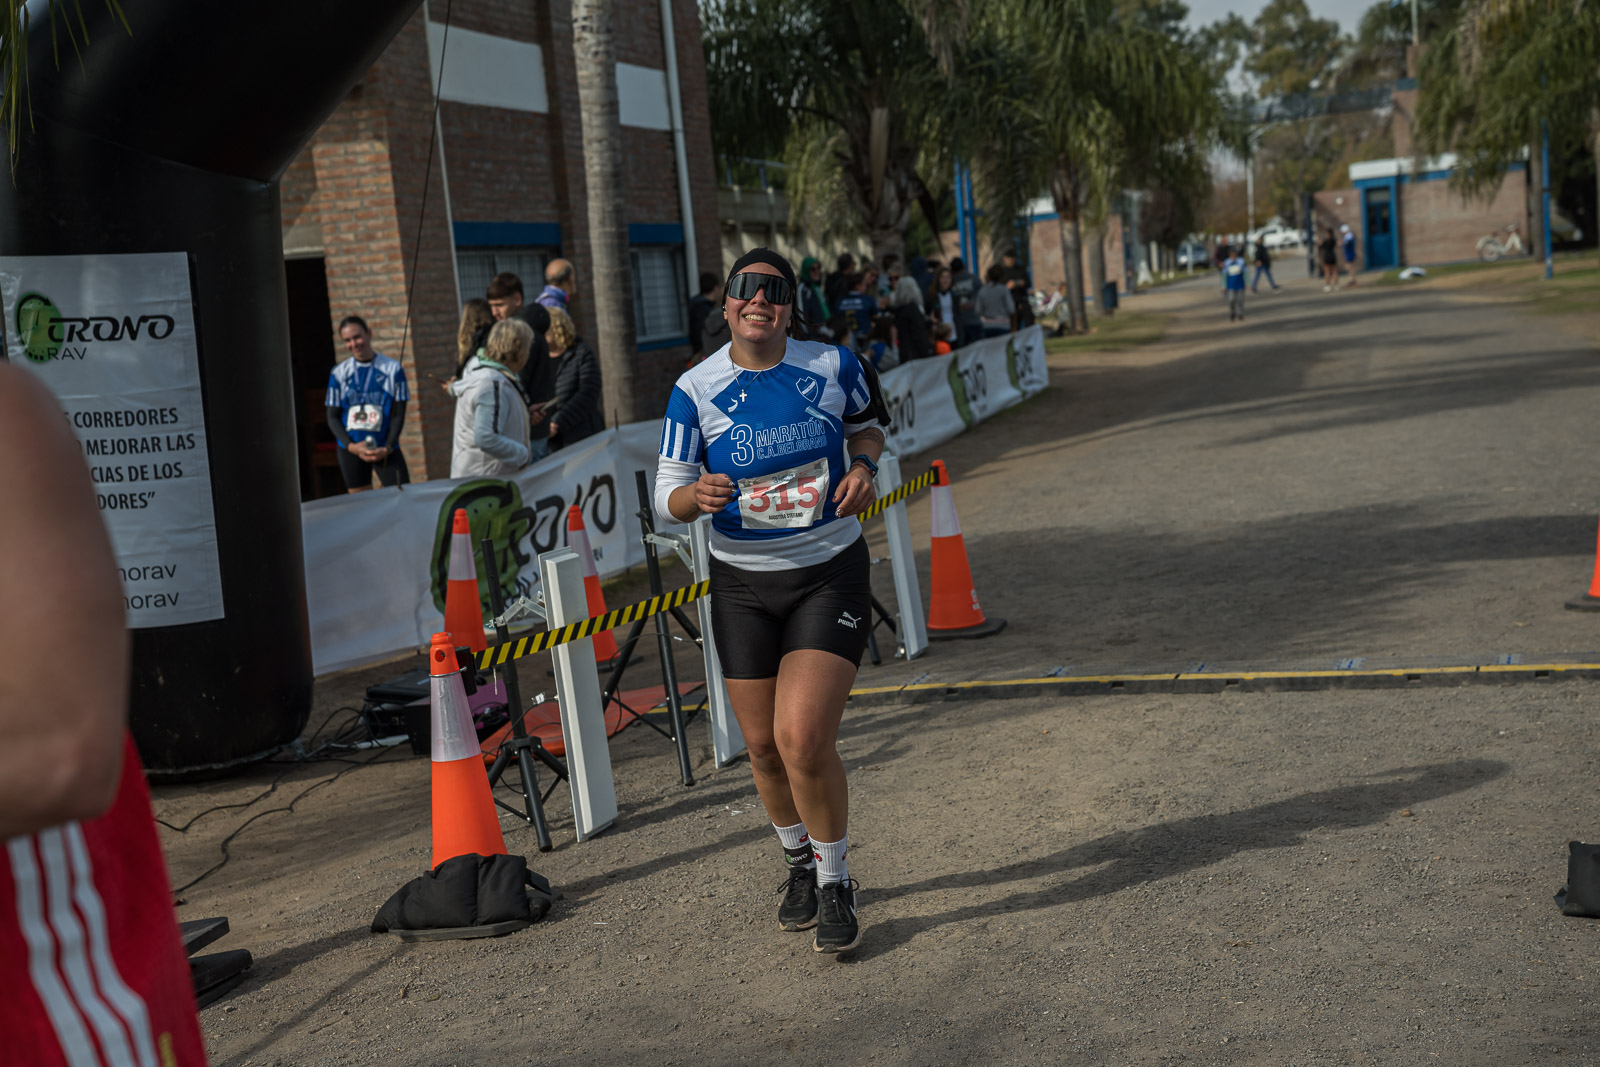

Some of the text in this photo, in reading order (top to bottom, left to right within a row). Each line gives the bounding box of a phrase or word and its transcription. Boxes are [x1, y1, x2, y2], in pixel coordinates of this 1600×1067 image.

[47, 314, 176, 343] CRONO
[47, 347, 88, 361] RAV
[73, 407, 179, 428] CORREDORES
[86, 435, 162, 456] MEJORAR
[166, 433, 196, 452] LAS
[730, 424, 755, 467] 3
[755, 417, 827, 448] MARATÓN
[127, 464, 150, 482] DE
[153, 462, 183, 480] LOS
[748, 476, 820, 513] 515
